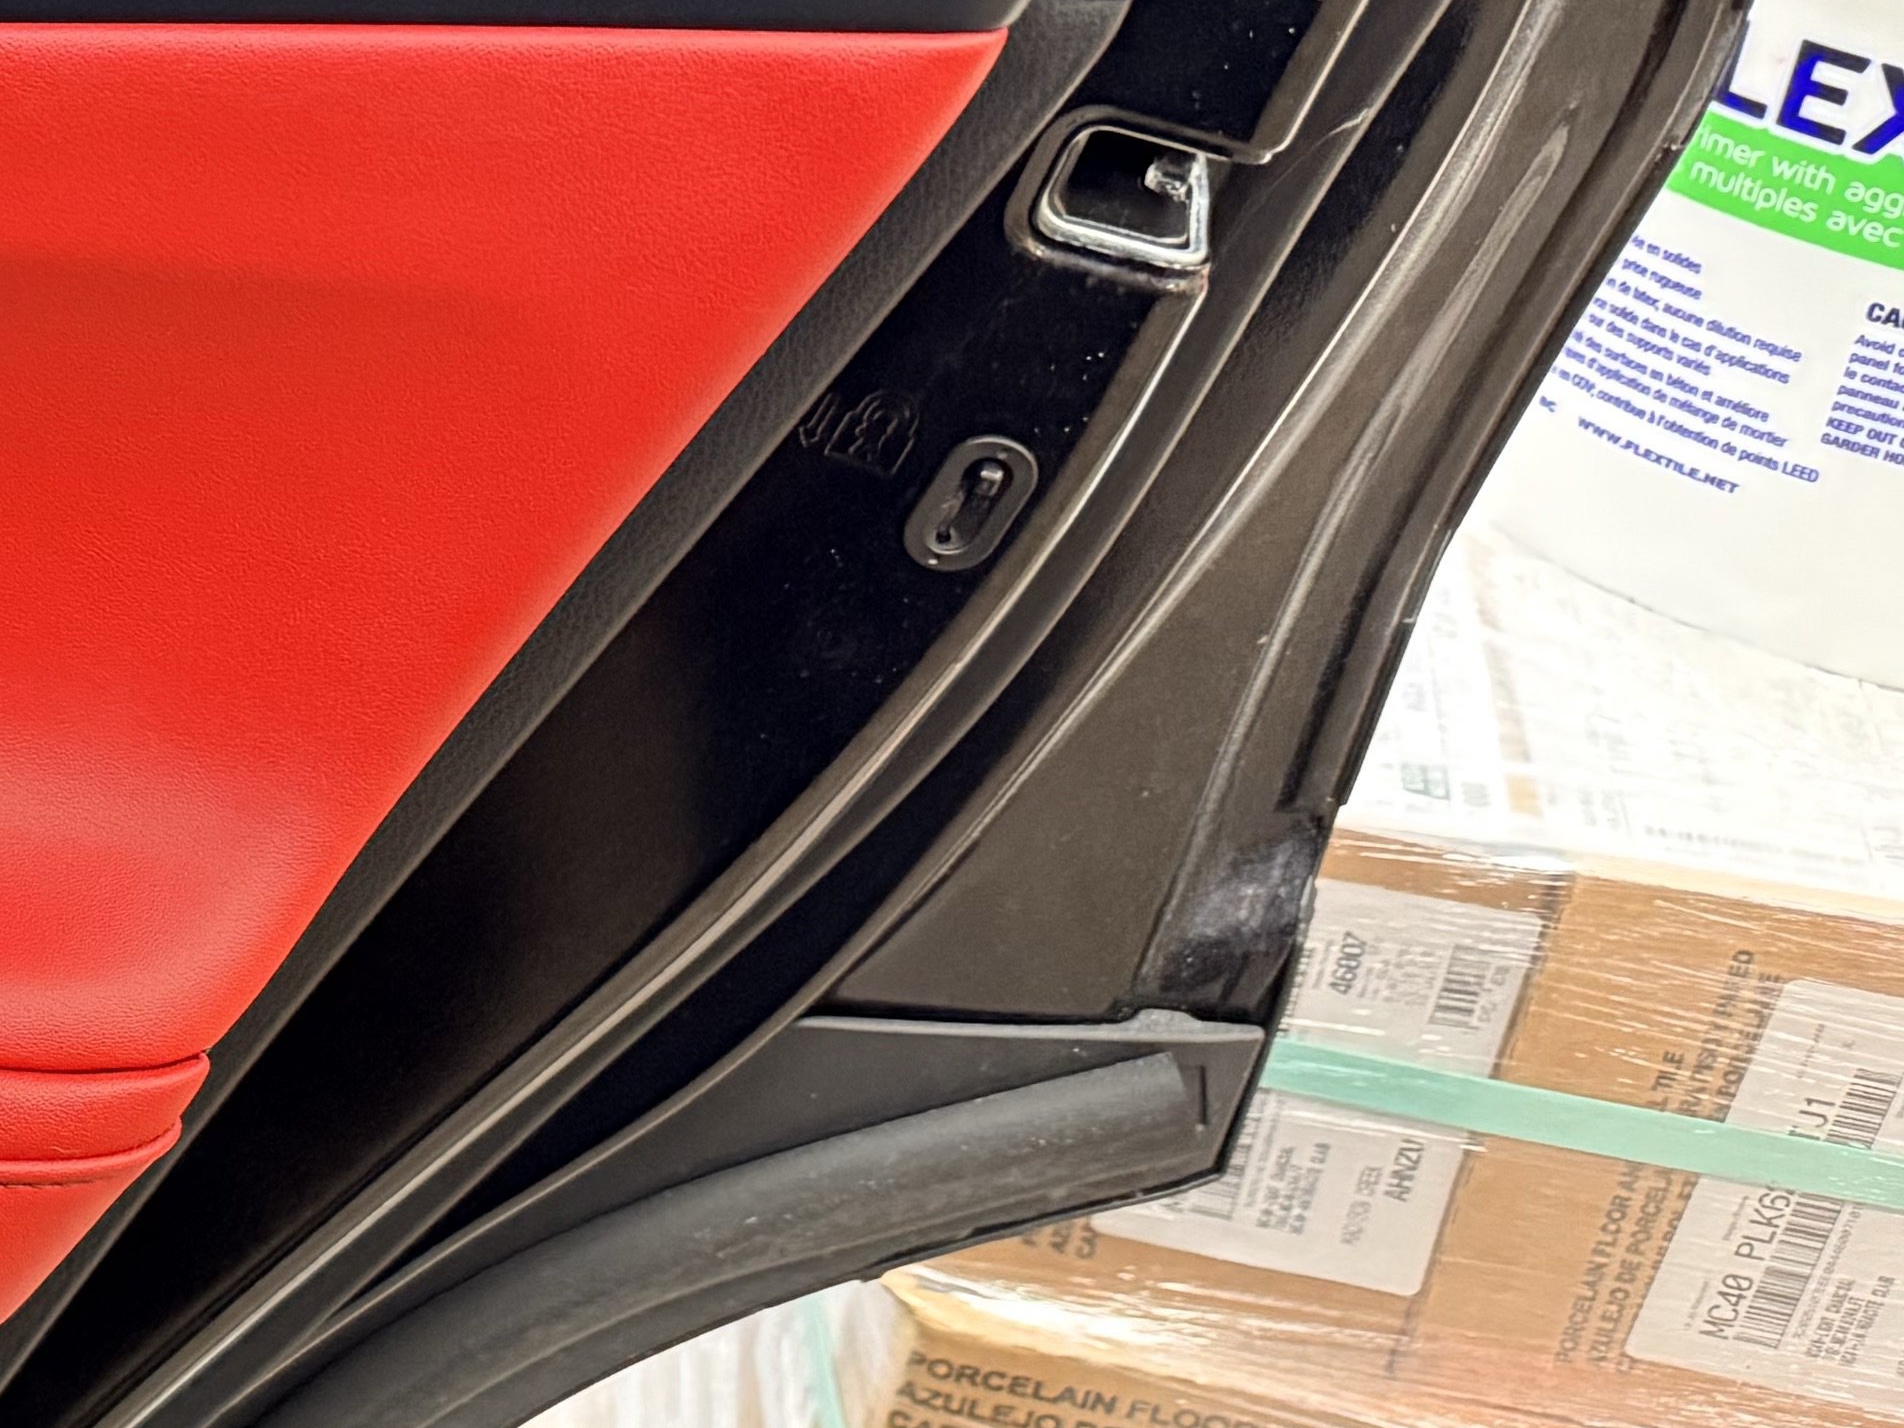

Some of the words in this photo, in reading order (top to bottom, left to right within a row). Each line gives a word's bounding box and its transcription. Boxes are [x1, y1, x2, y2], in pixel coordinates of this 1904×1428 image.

[1698, 124, 1765, 168] imer
[1772, 156, 1837, 195] with
[1844, 181, 1904, 219] agg
[1690, 161, 1820, 223] multiples
[1826, 210, 1904, 248] avec
[1865, 302, 1904, 330] CA
[1753, 338, 1802, 362] requise
[1854, 334, 1896, 355] Avoid
[1843, 366, 1858, 380] le
[1848, 352, 1890, 371] panel
[1836, 384, 1900, 410] panneau
[1739, 424, 1789, 448] mortier
[1825, 416, 1865, 435] KEEP
[1866, 428, 1898, 445] OUT
[1820, 432, 1881, 459] GARDER
[1738, 449, 1780, 471] points
[1781, 461, 1820, 483] LEED
[1698, 1272, 1754, 1340] MC40
[908, 1349, 1118, 1415] PORCELAIN
